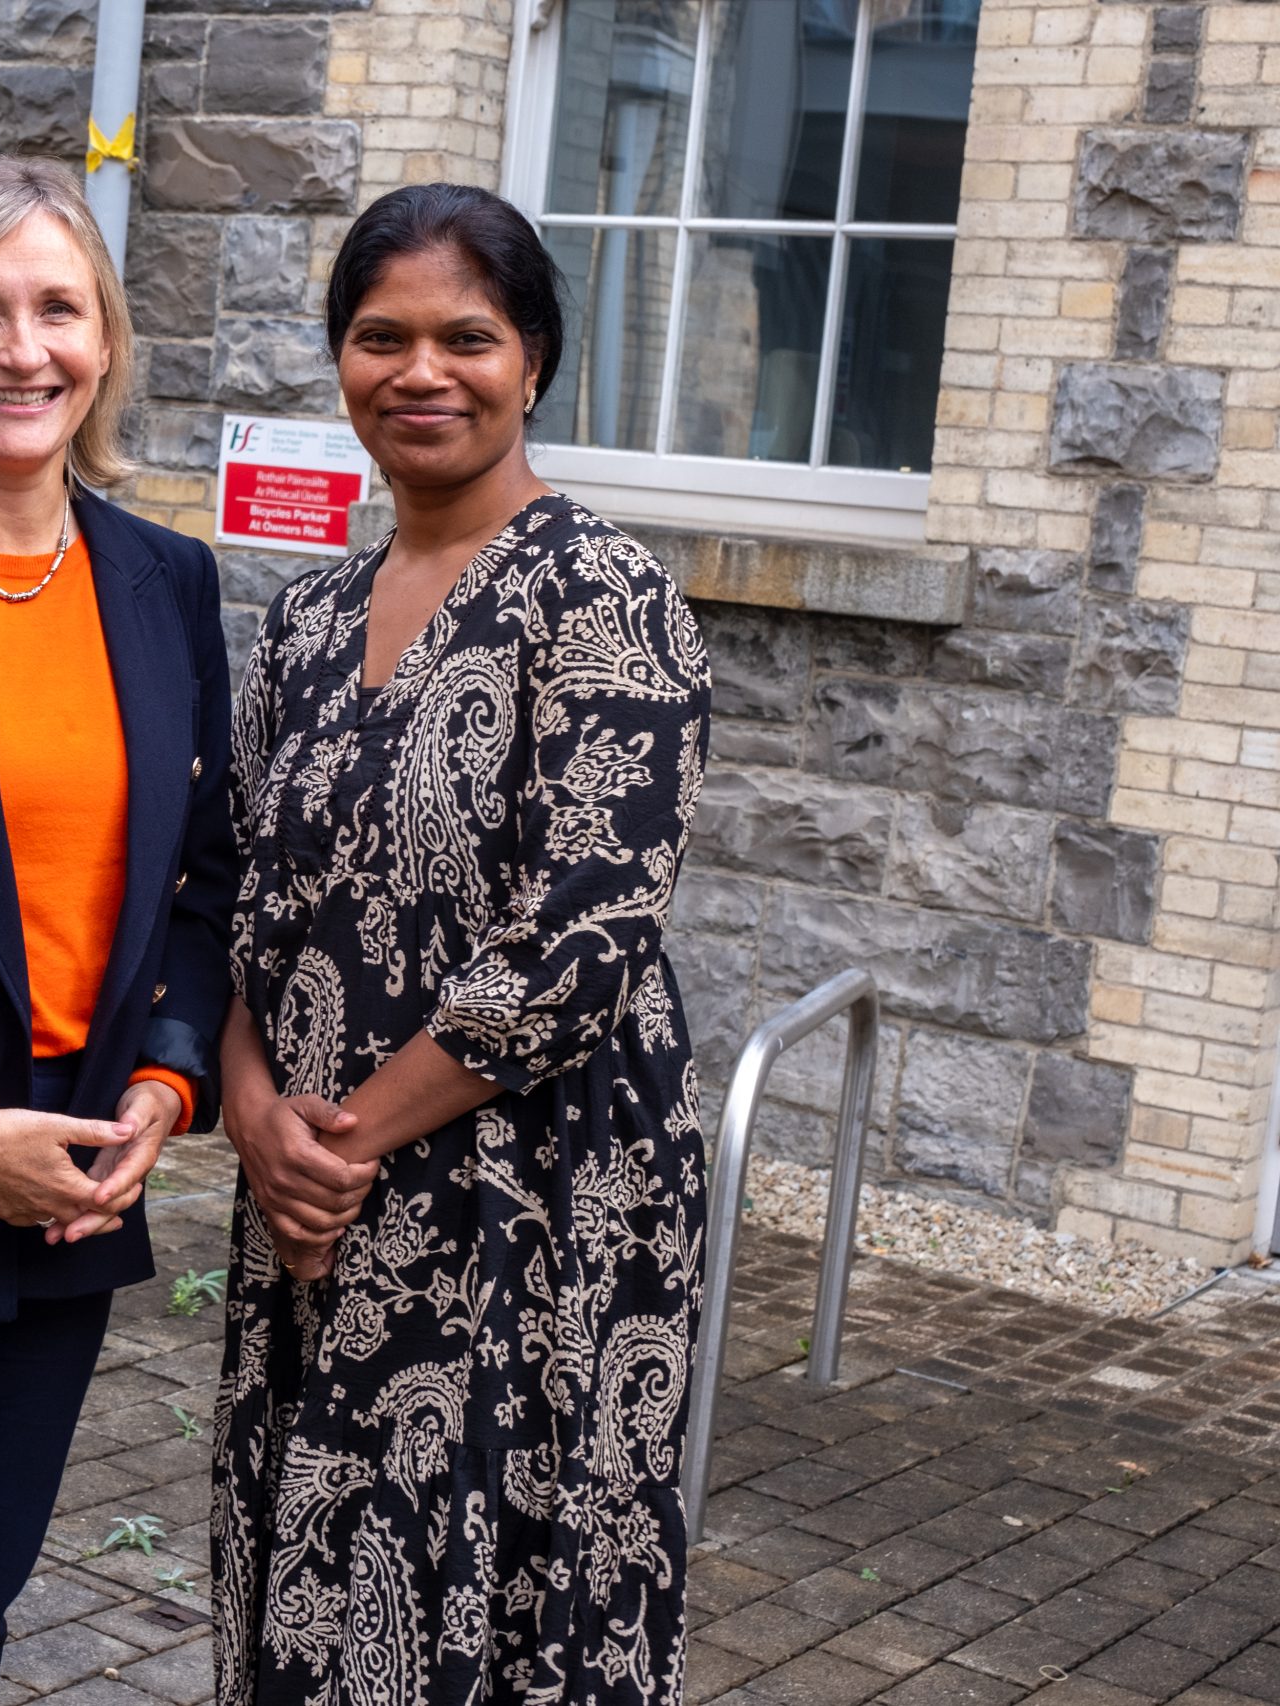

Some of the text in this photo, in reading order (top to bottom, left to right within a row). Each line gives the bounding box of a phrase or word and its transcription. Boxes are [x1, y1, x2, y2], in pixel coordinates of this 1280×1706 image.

[249, 504, 331, 524] Bicycles Parked
[249, 519, 326, 538] At Owners Risk
